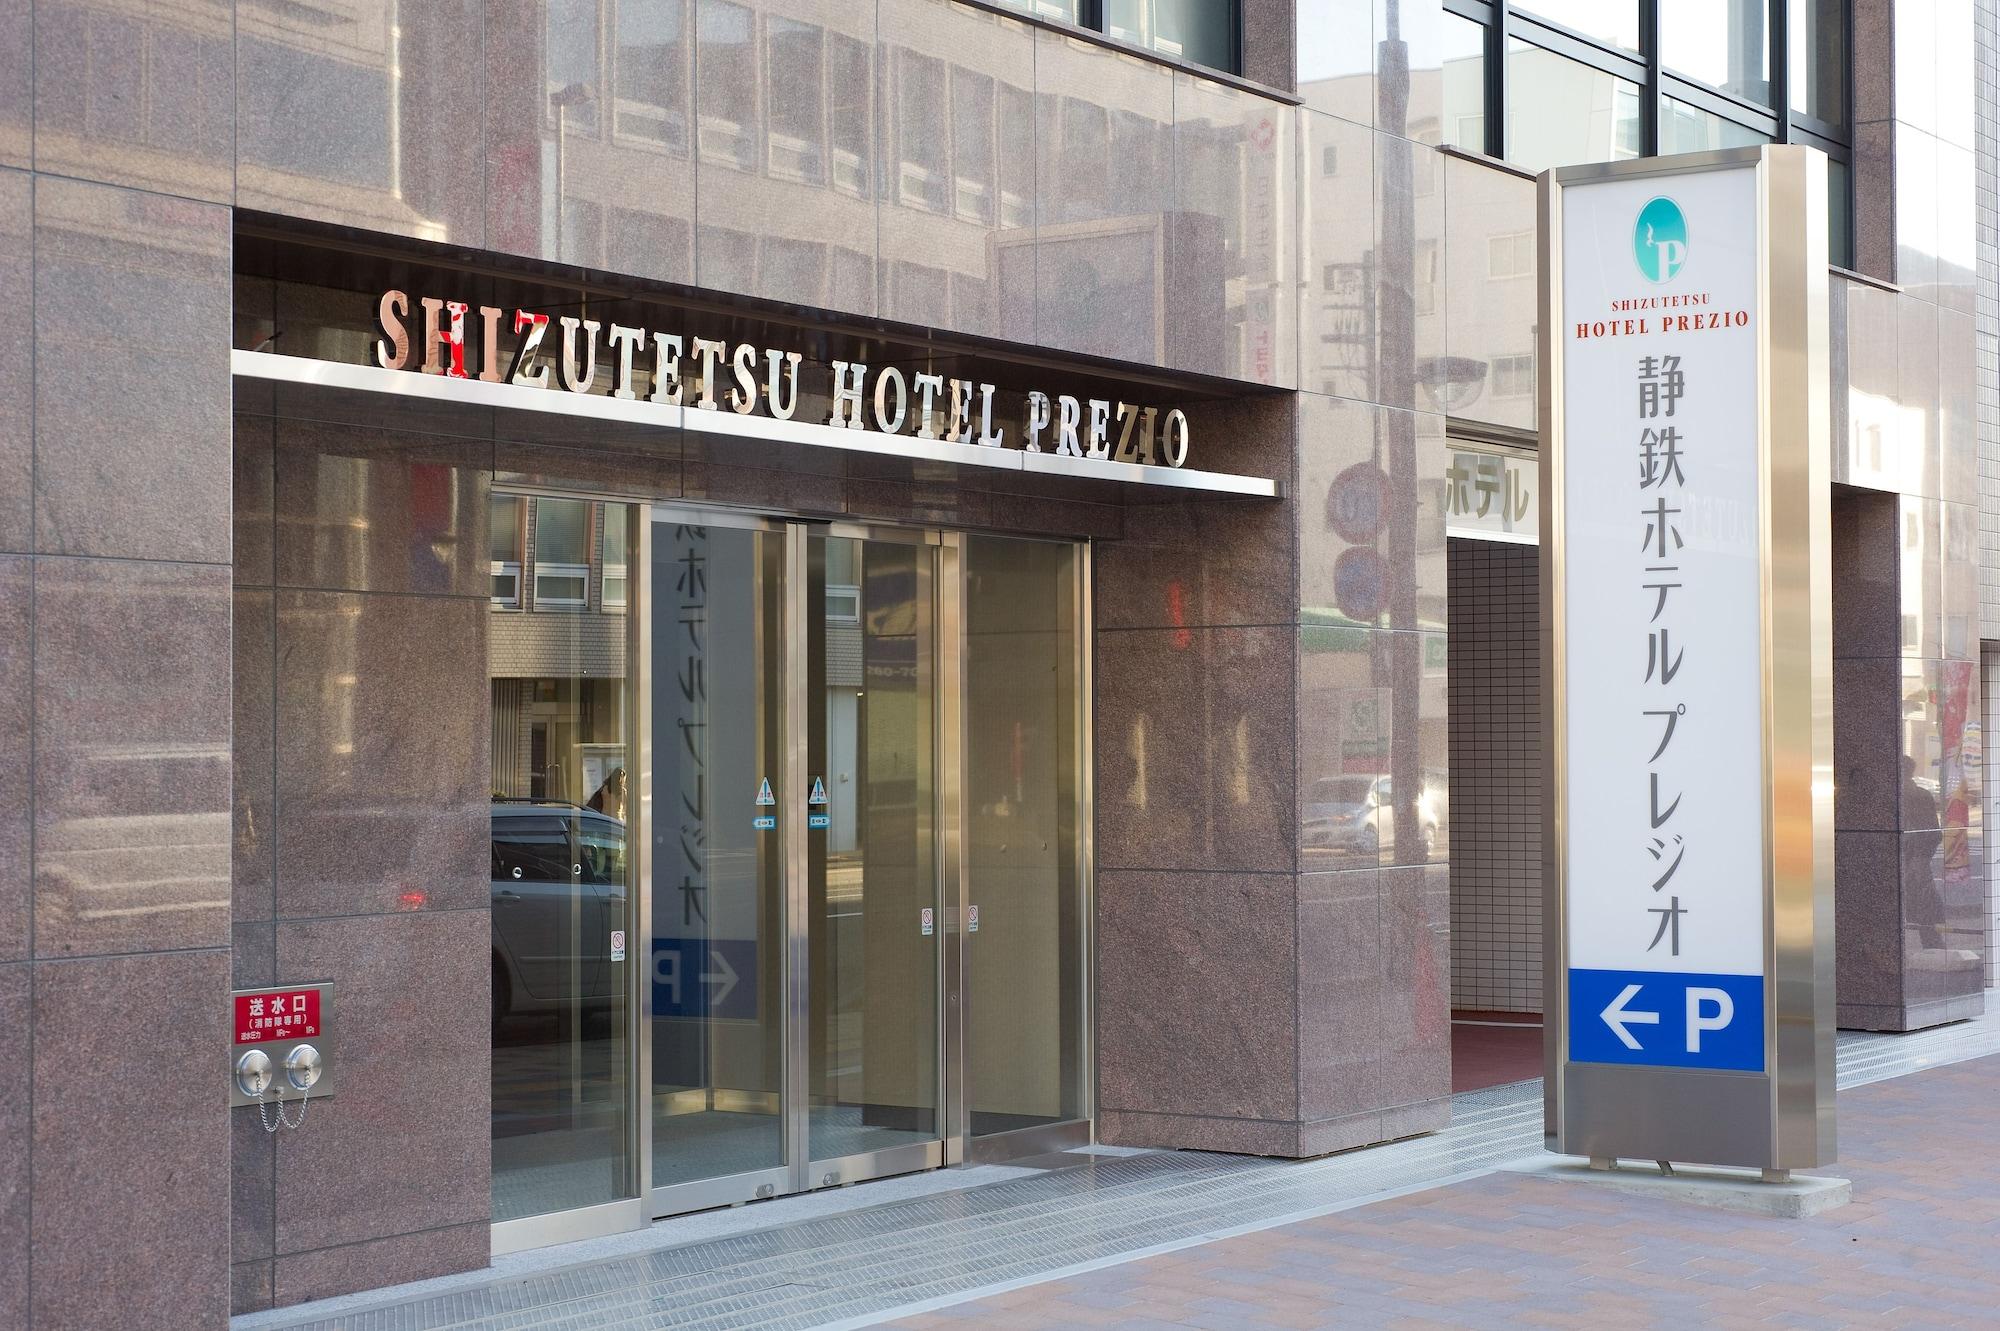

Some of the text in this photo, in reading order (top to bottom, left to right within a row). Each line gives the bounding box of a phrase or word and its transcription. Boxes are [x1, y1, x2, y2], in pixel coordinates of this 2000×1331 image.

[1576, 310, 1749, 339] HOTEL PREZIO
[1611, 293, 1711, 312] SHIZUTETSU
[377, 289, 1190, 468] SHIZUTETSU HOTEL PREZIO
[1637, 354, 1689, 957] 静鉄ホテルプレジオ
[249, 995, 306, 1017] 送水口
[1685, 986, 1735, 1054] P
